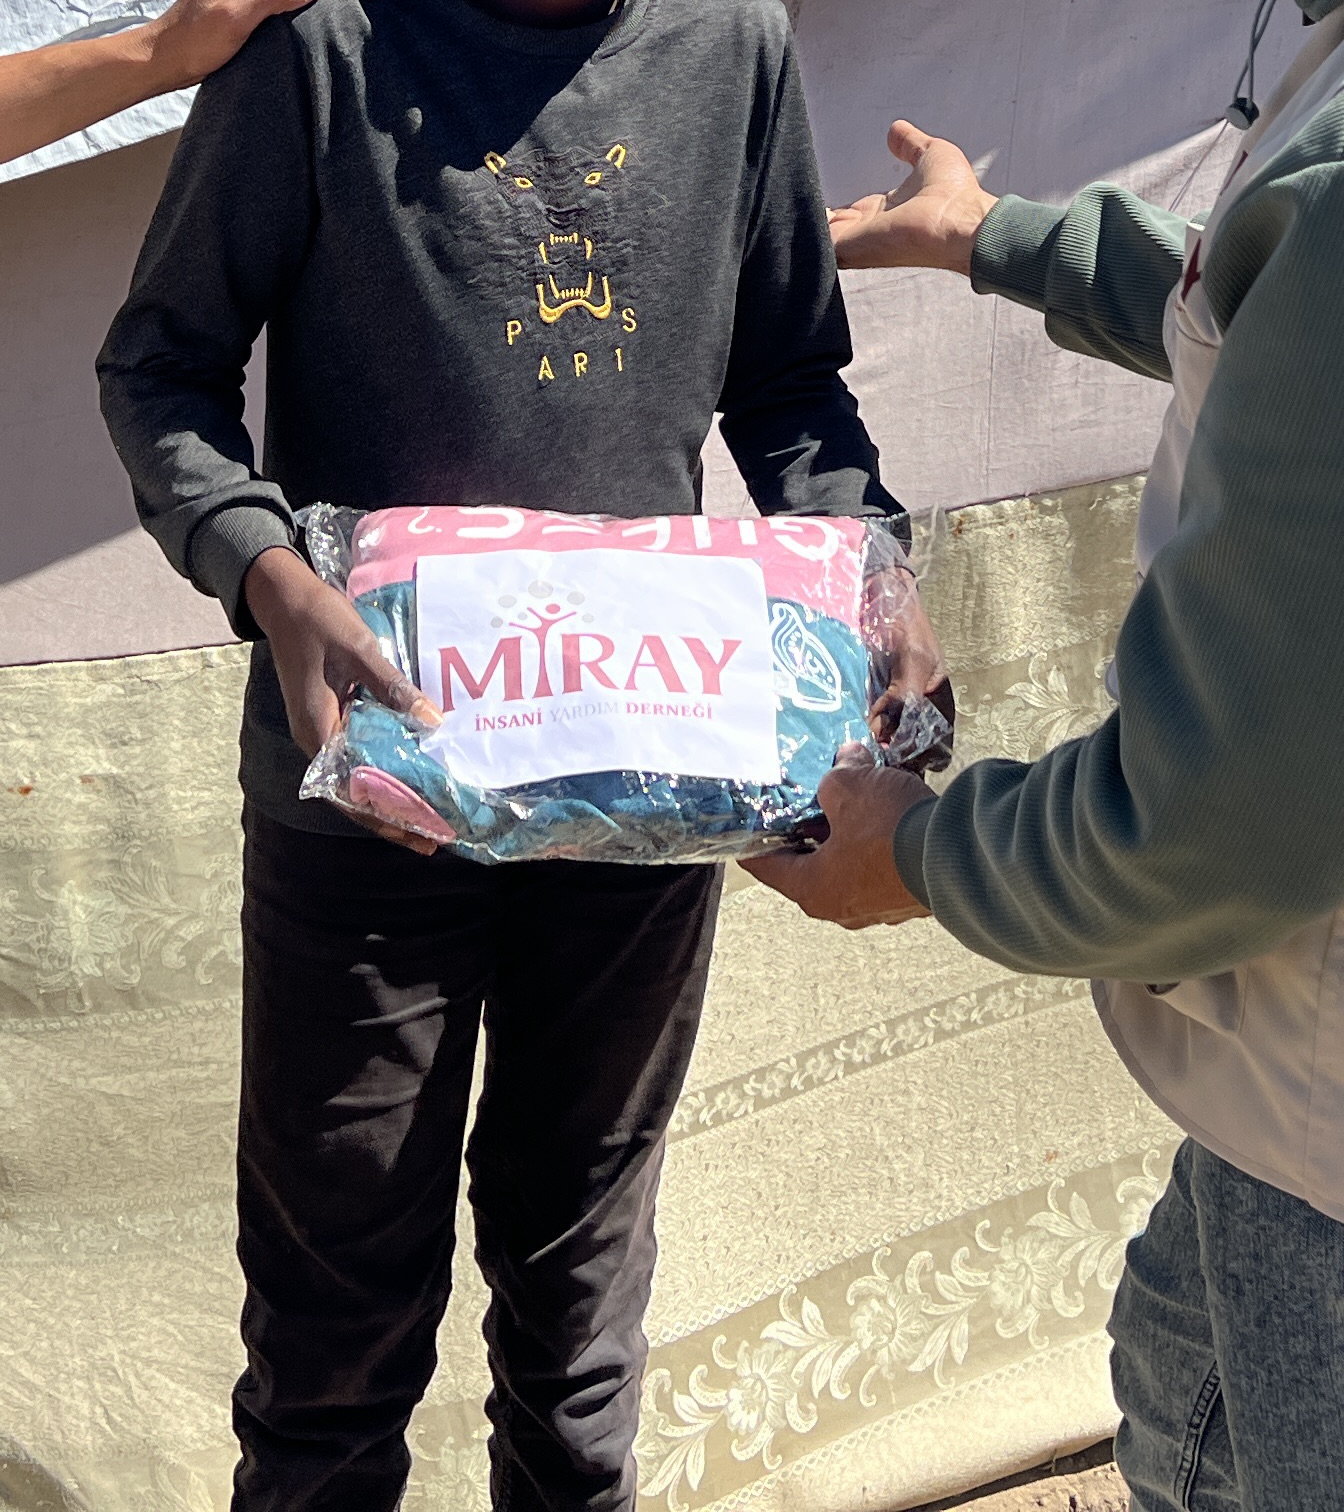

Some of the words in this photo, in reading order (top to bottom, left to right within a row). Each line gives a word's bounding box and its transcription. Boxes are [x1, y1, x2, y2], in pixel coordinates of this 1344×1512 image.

[474, 707, 544, 732] İNSANİ
[549, 700, 620, 722] YARDIM
[625, 701, 714, 720] DERNEĞİ
